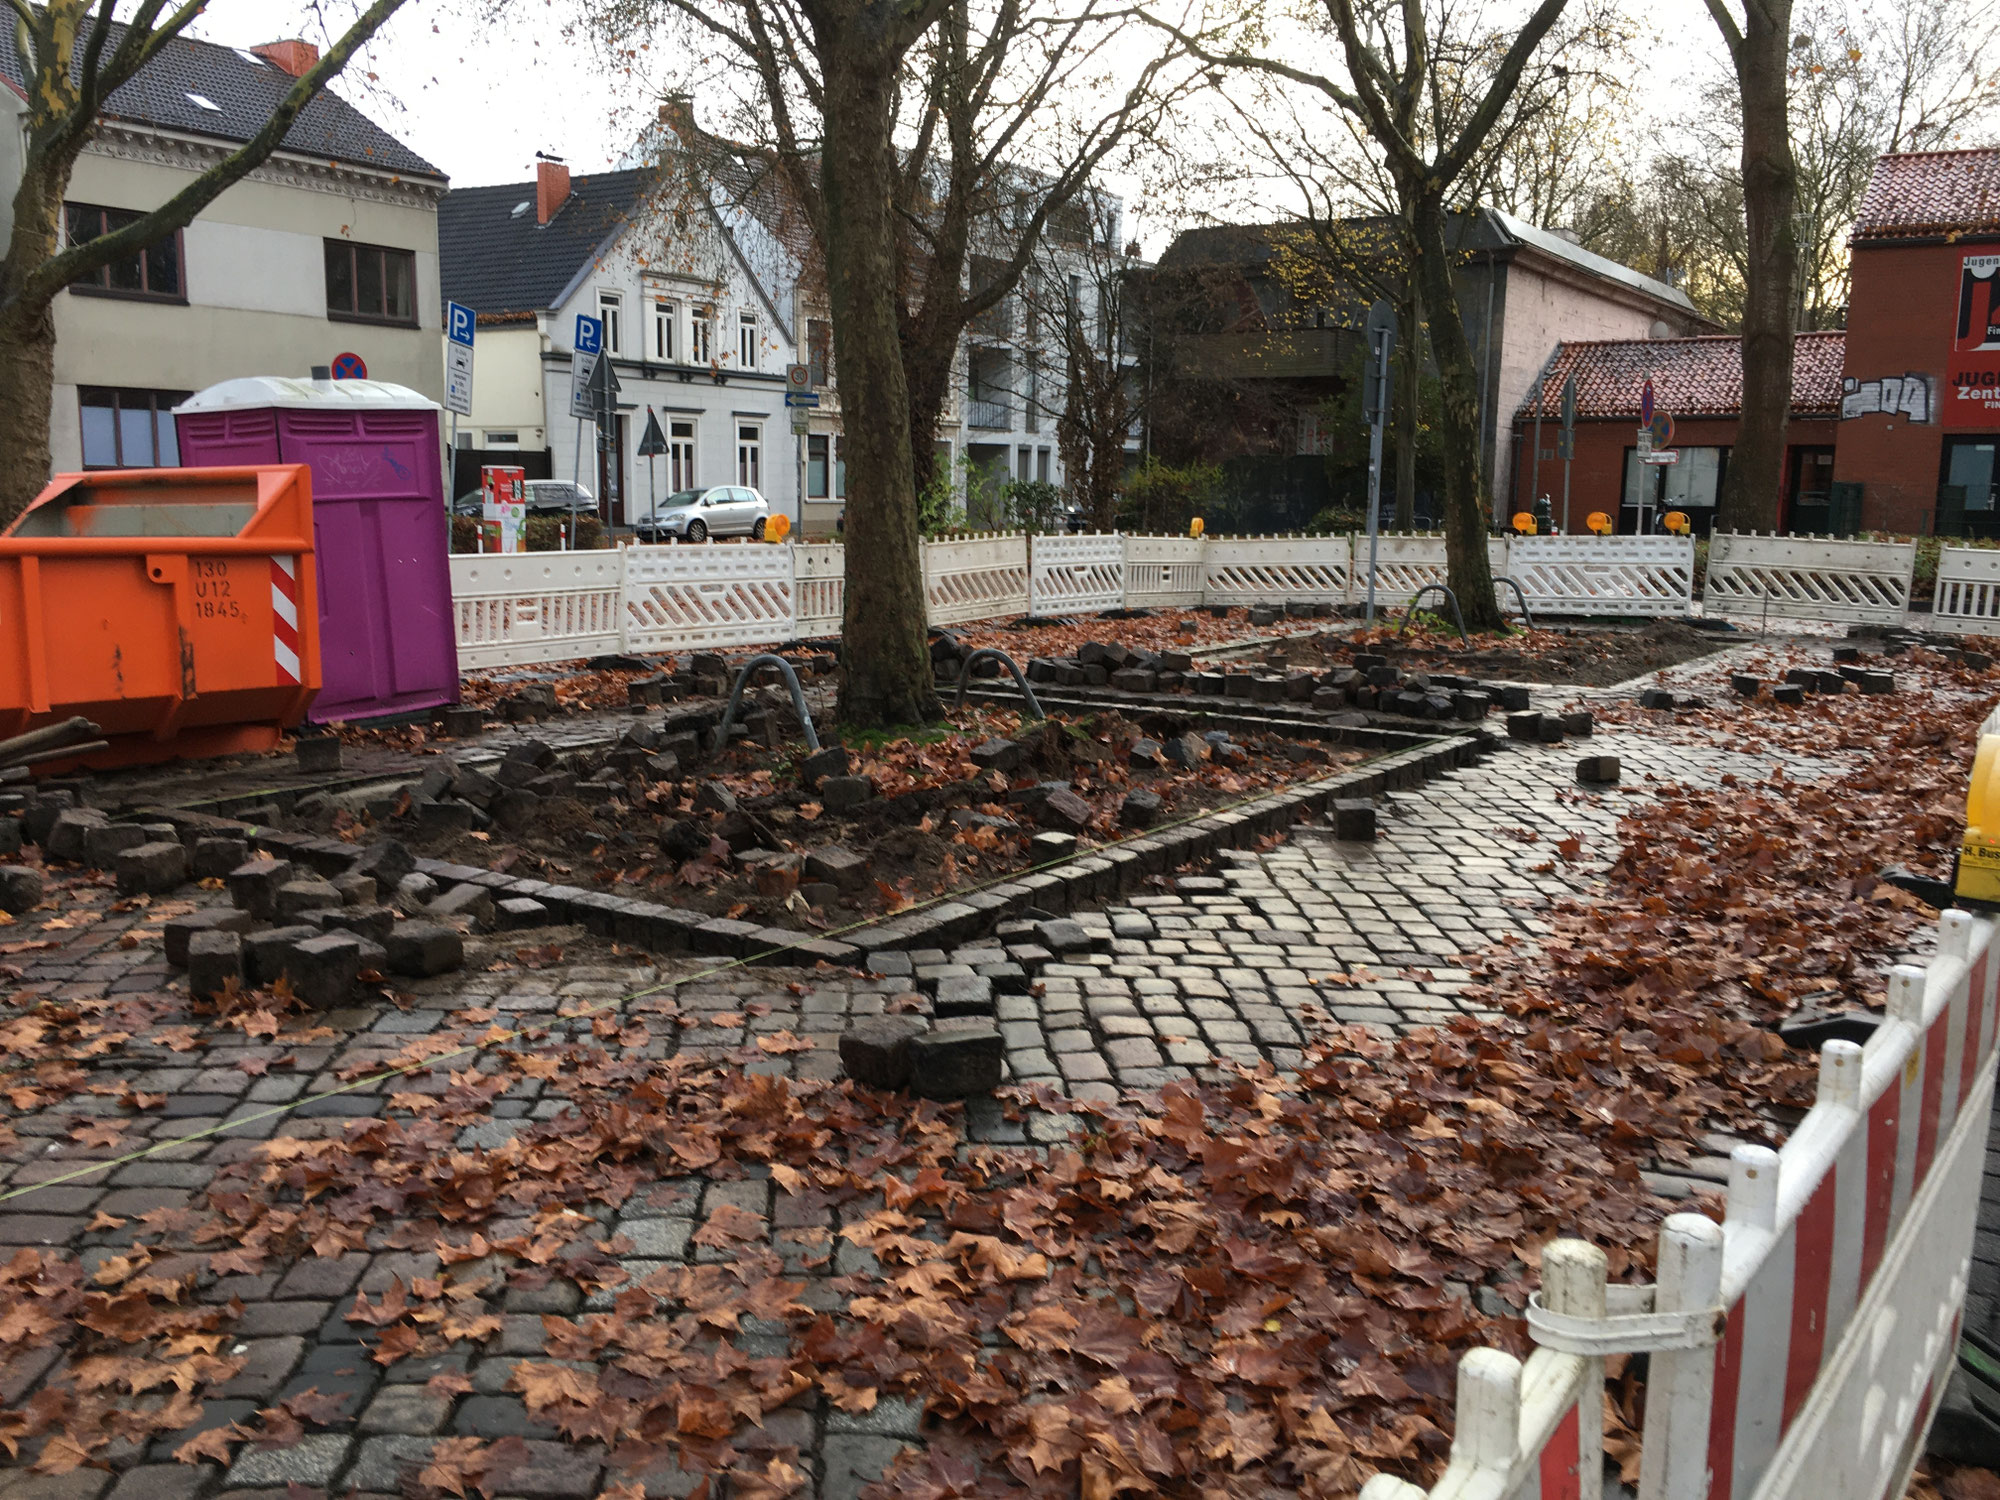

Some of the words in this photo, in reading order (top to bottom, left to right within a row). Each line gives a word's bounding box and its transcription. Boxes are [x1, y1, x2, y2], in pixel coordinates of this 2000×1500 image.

[1963, 257, 1999, 268] Jugen
[453, 308, 467, 337] P
[579, 320, 594, 347] P
[1952, 371, 2000, 387] JUG
[1957, 386, 2000, 400] Zent
[197, 561, 227, 578] 130
[196, 601, 240, 618] 1845
